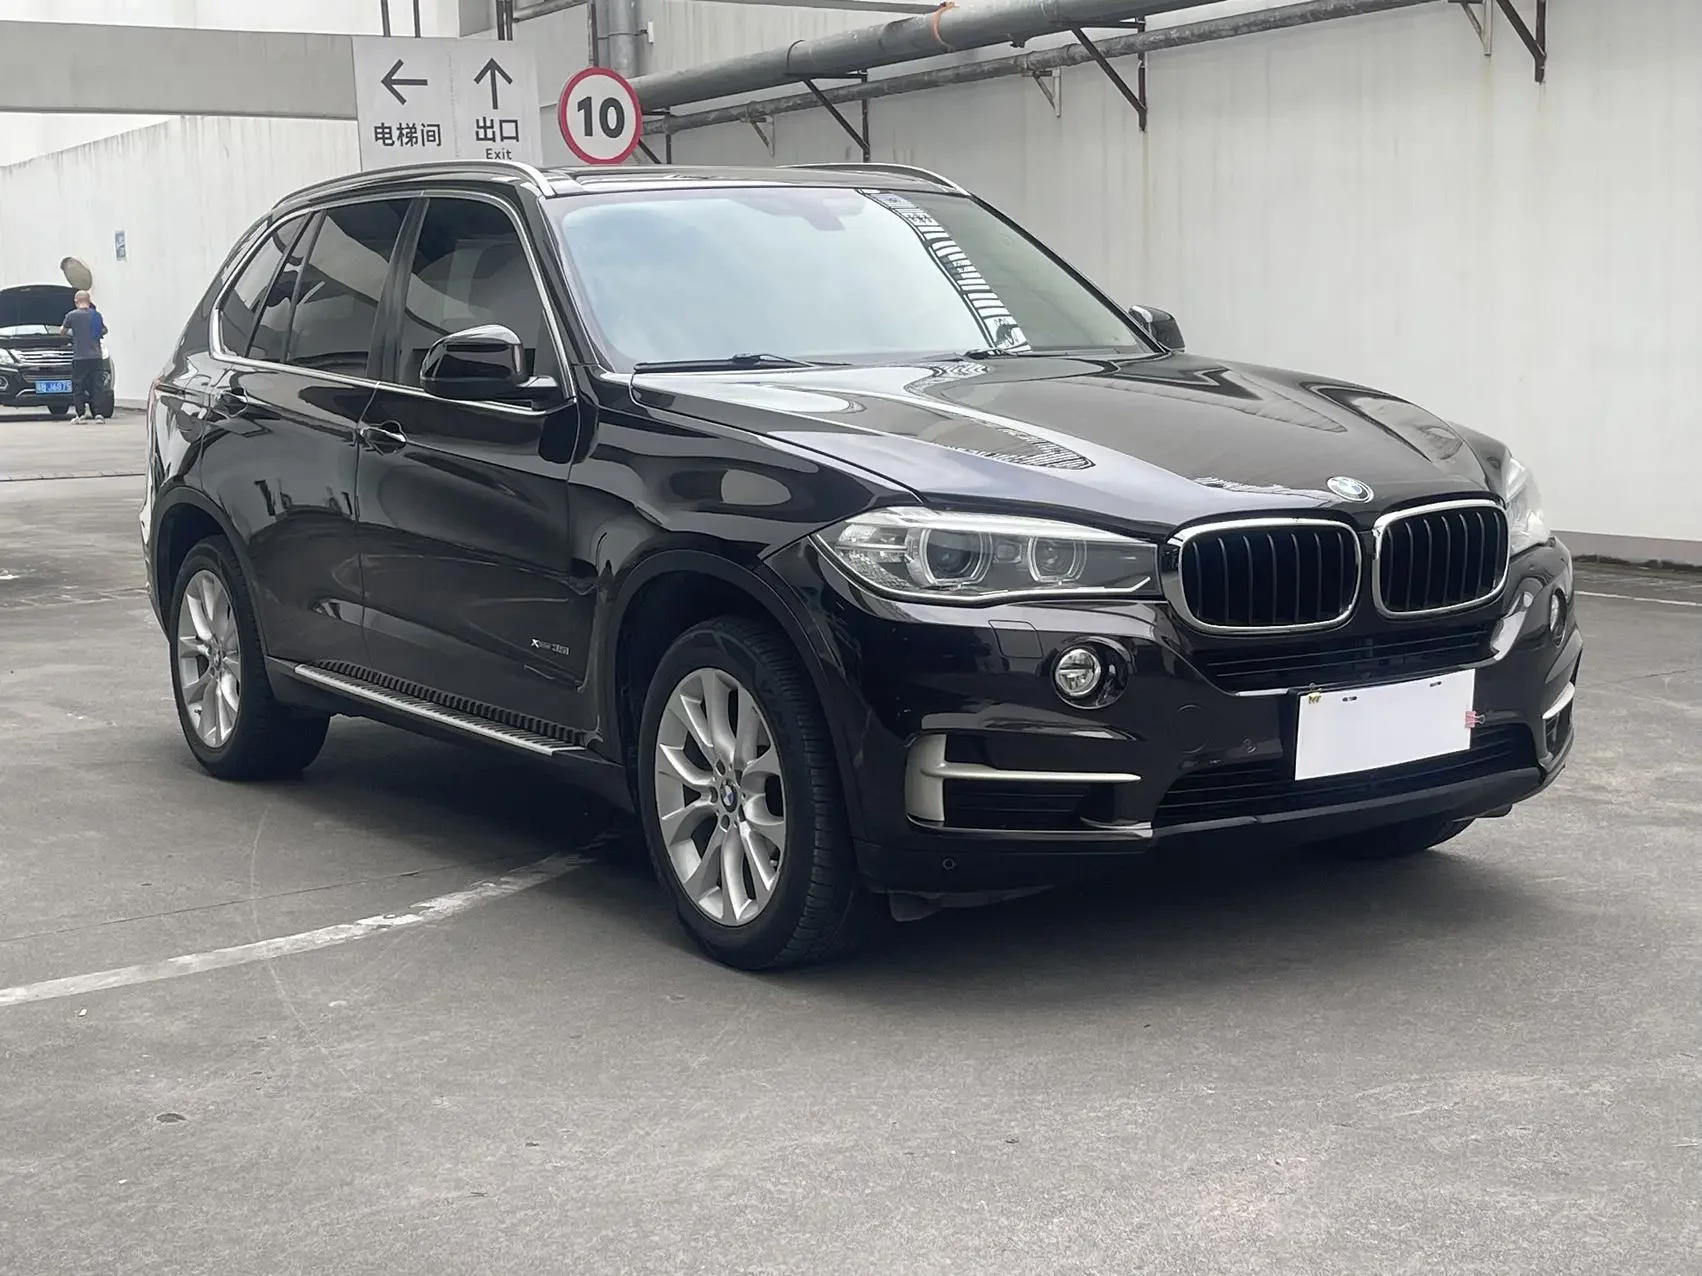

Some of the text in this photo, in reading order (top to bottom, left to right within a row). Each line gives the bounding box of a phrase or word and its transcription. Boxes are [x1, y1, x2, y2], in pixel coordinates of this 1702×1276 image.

[475, 116, 519, 142] 出口
[577, 96, 625, 138] 10
[374, 122, 442, 147] 电梯间
[485, 147, 512, 160] Exit
